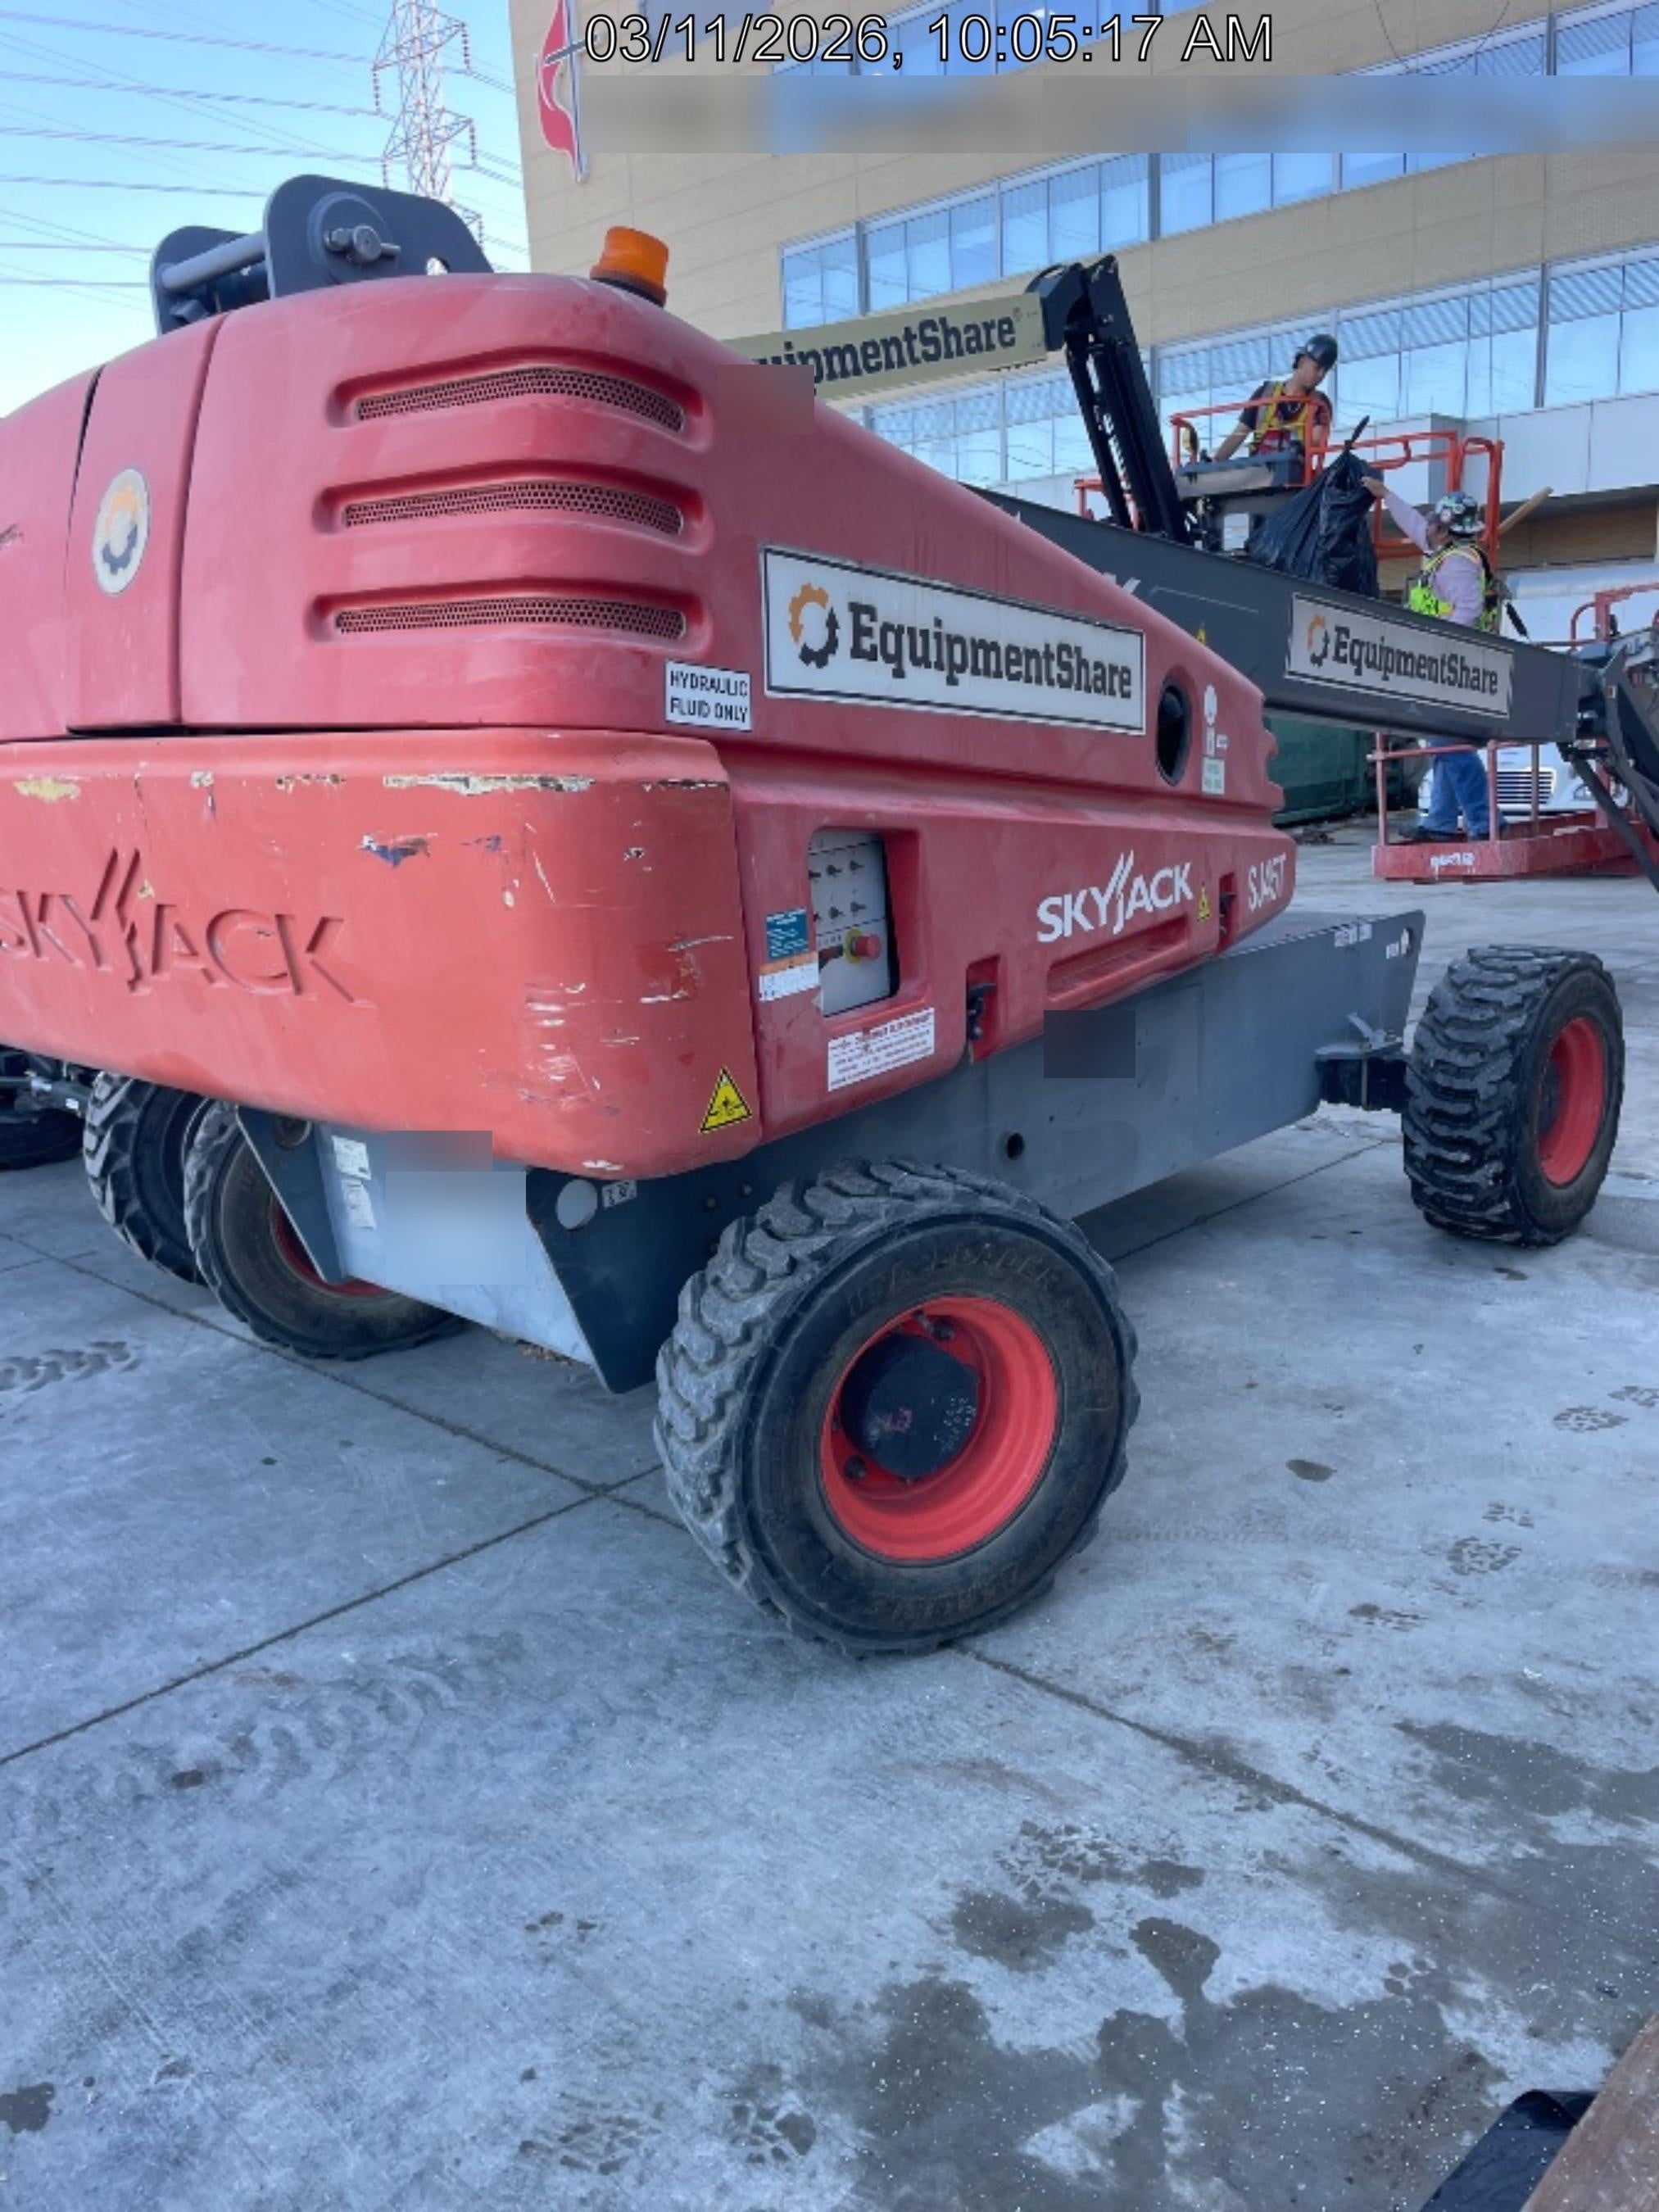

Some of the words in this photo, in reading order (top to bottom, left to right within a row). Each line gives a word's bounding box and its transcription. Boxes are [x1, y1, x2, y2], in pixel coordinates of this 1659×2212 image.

[669, 670, 748, 696] HYDRAULIC
[847, 601, 1132, 700] EquipmentShare
[1333, 626, 1498, 695] EquipmentShare
[670, 696, 711, 718] FLUID
[714, 702, 747, 723] ONLY
[1036, 849, 1194, 942] SKYJACK
